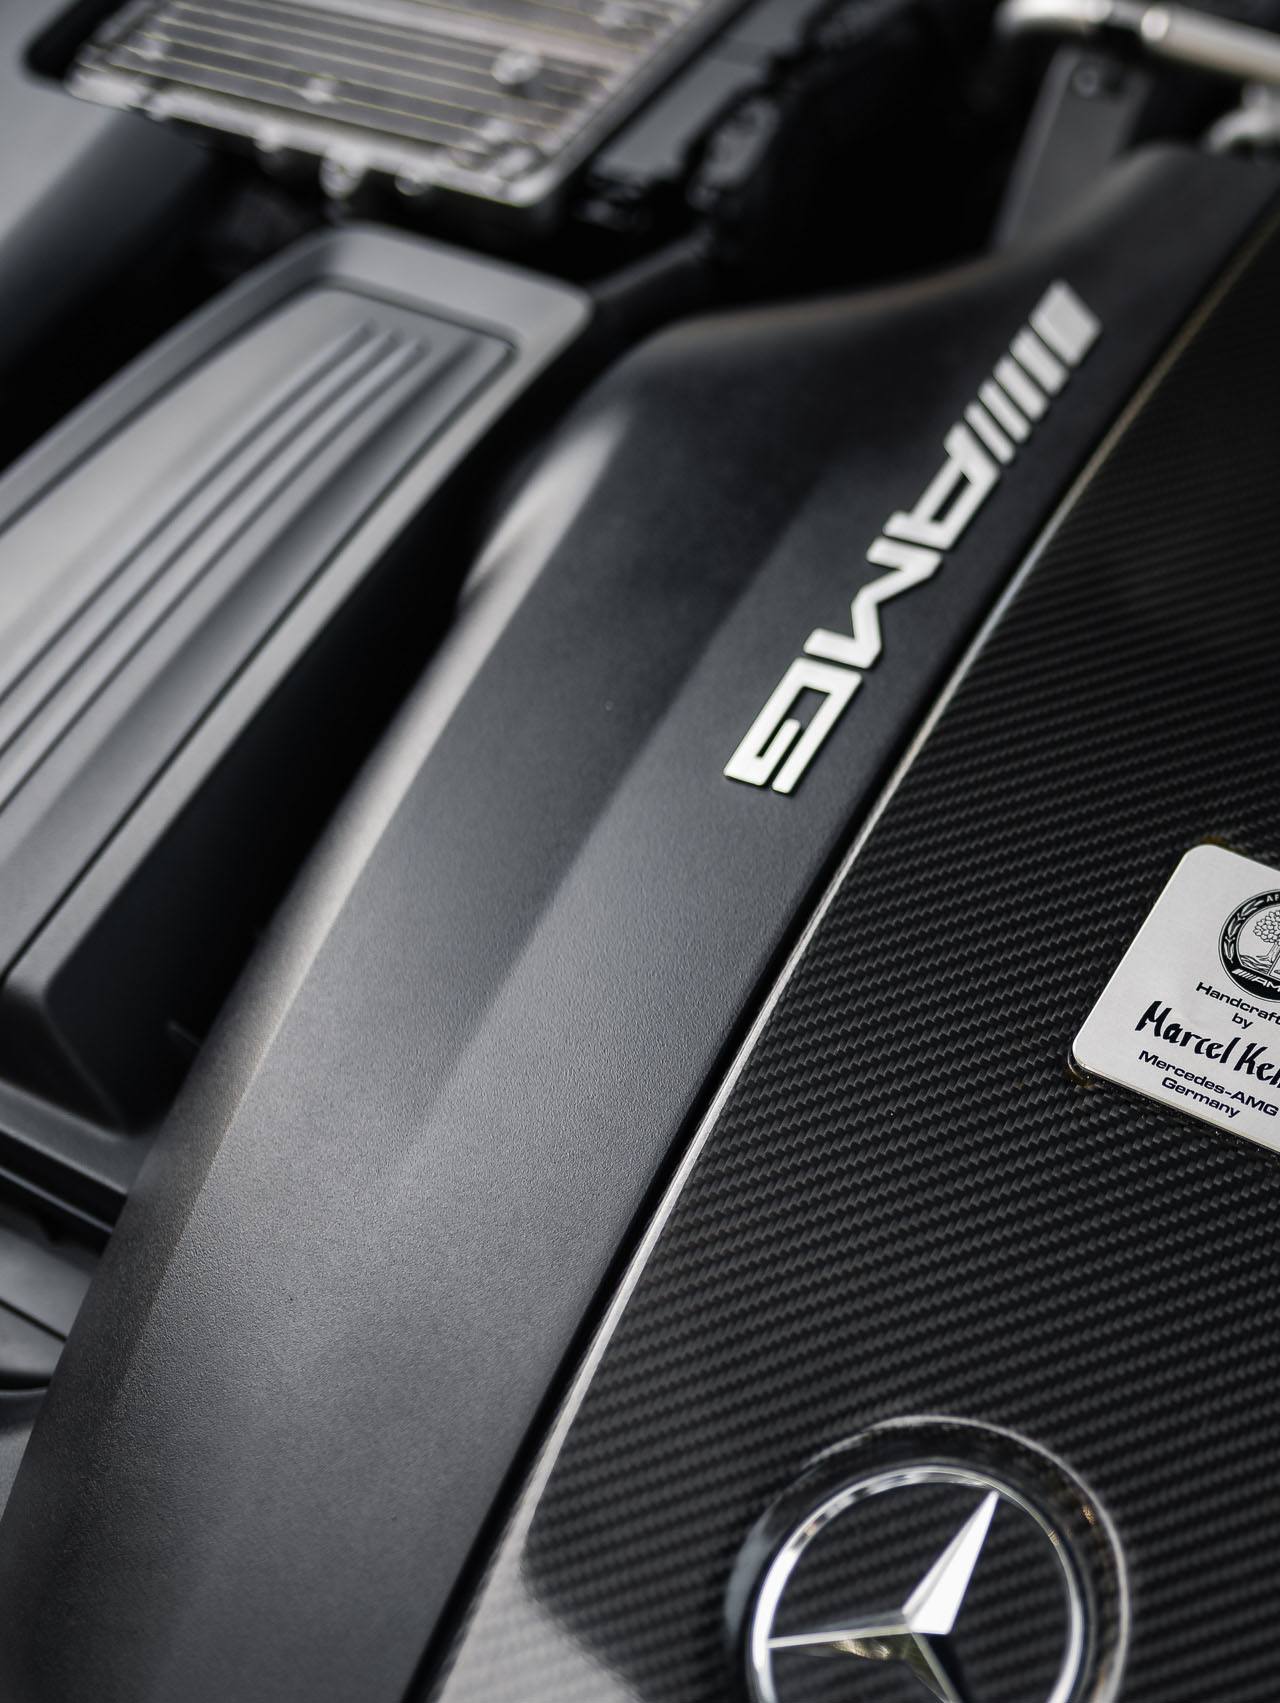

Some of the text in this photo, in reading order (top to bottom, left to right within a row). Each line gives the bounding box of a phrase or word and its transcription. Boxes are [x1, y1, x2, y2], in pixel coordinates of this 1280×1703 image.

[723, 421, 1001, 795] AMG
[1134, 1000, 1241, 1064] Marcel
[1231, 1013, 1253, 1029] by
[1138, 1050, 1279, 1117] Mercedes-AMG
[1161, 1076, 1241, 1118] Germany
